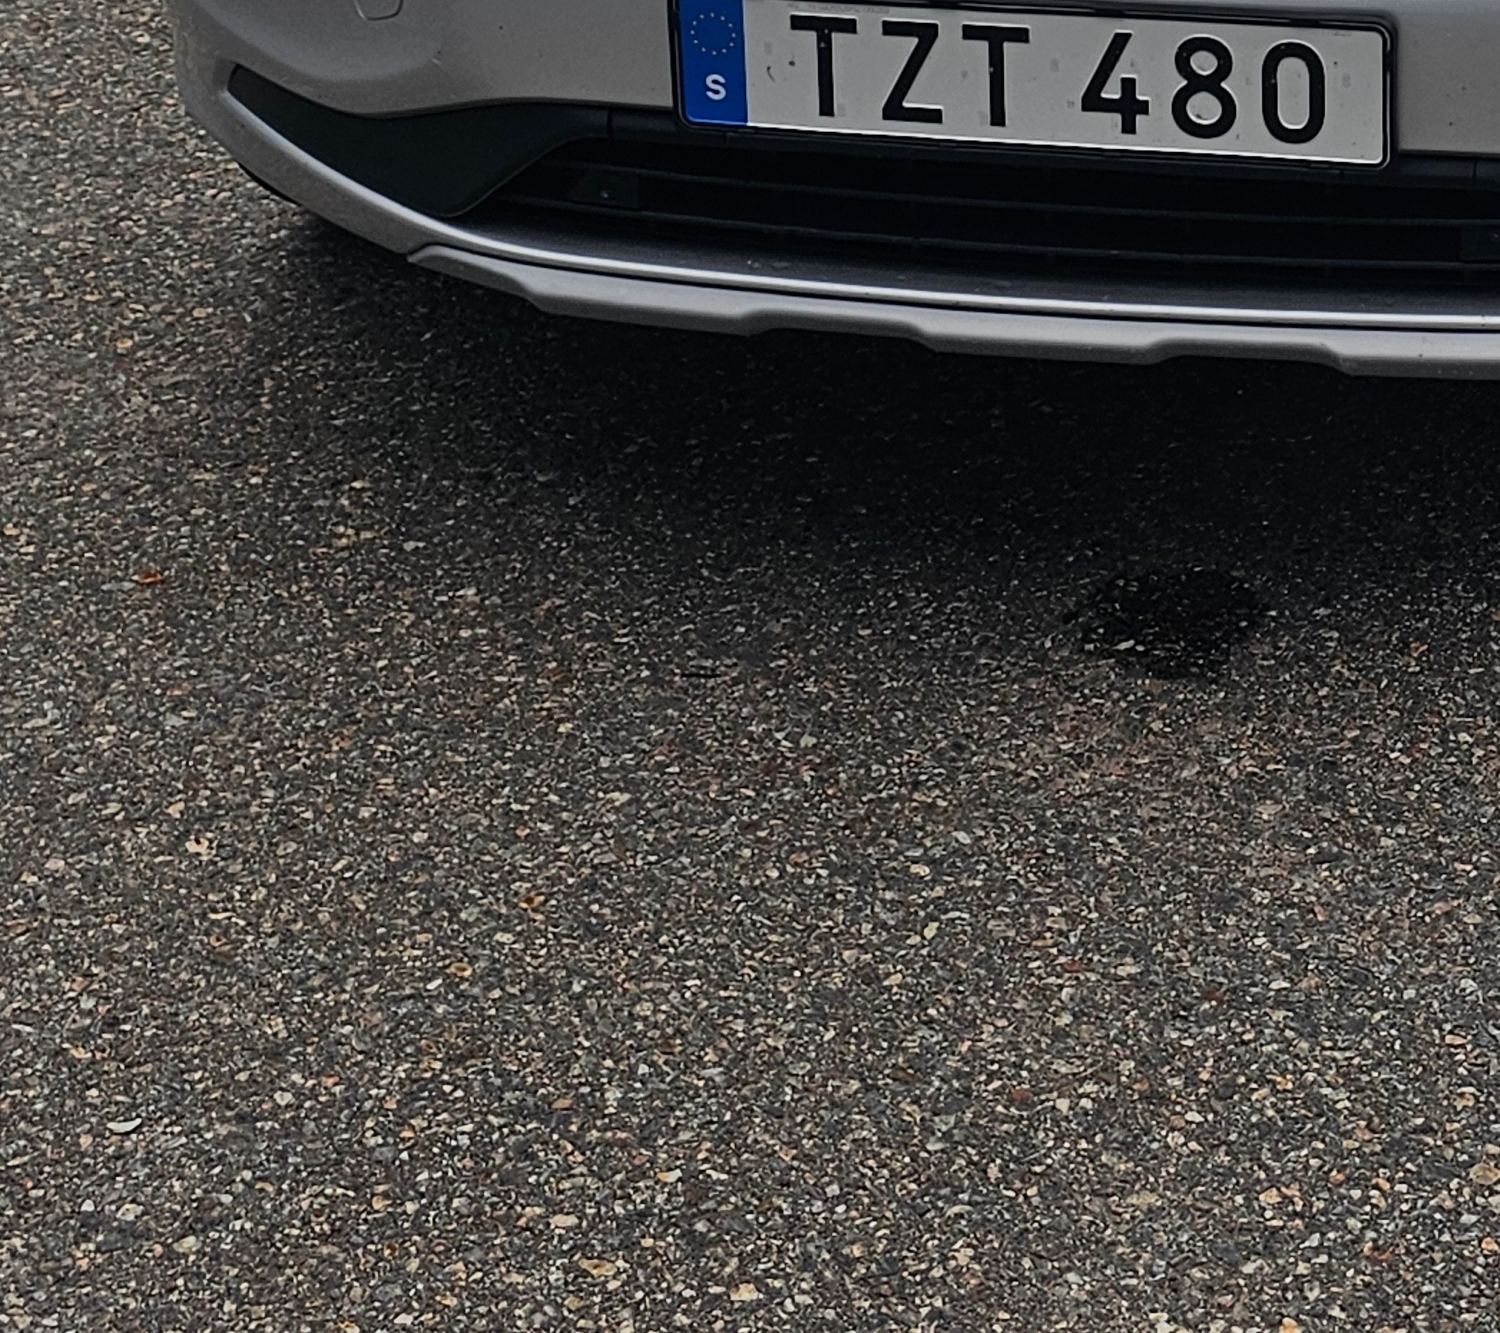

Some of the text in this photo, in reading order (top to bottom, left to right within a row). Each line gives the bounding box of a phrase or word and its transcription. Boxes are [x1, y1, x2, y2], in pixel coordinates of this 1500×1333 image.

[705, 74, 727, 101] S
[790, 13, 1326, 144] TZT 480
